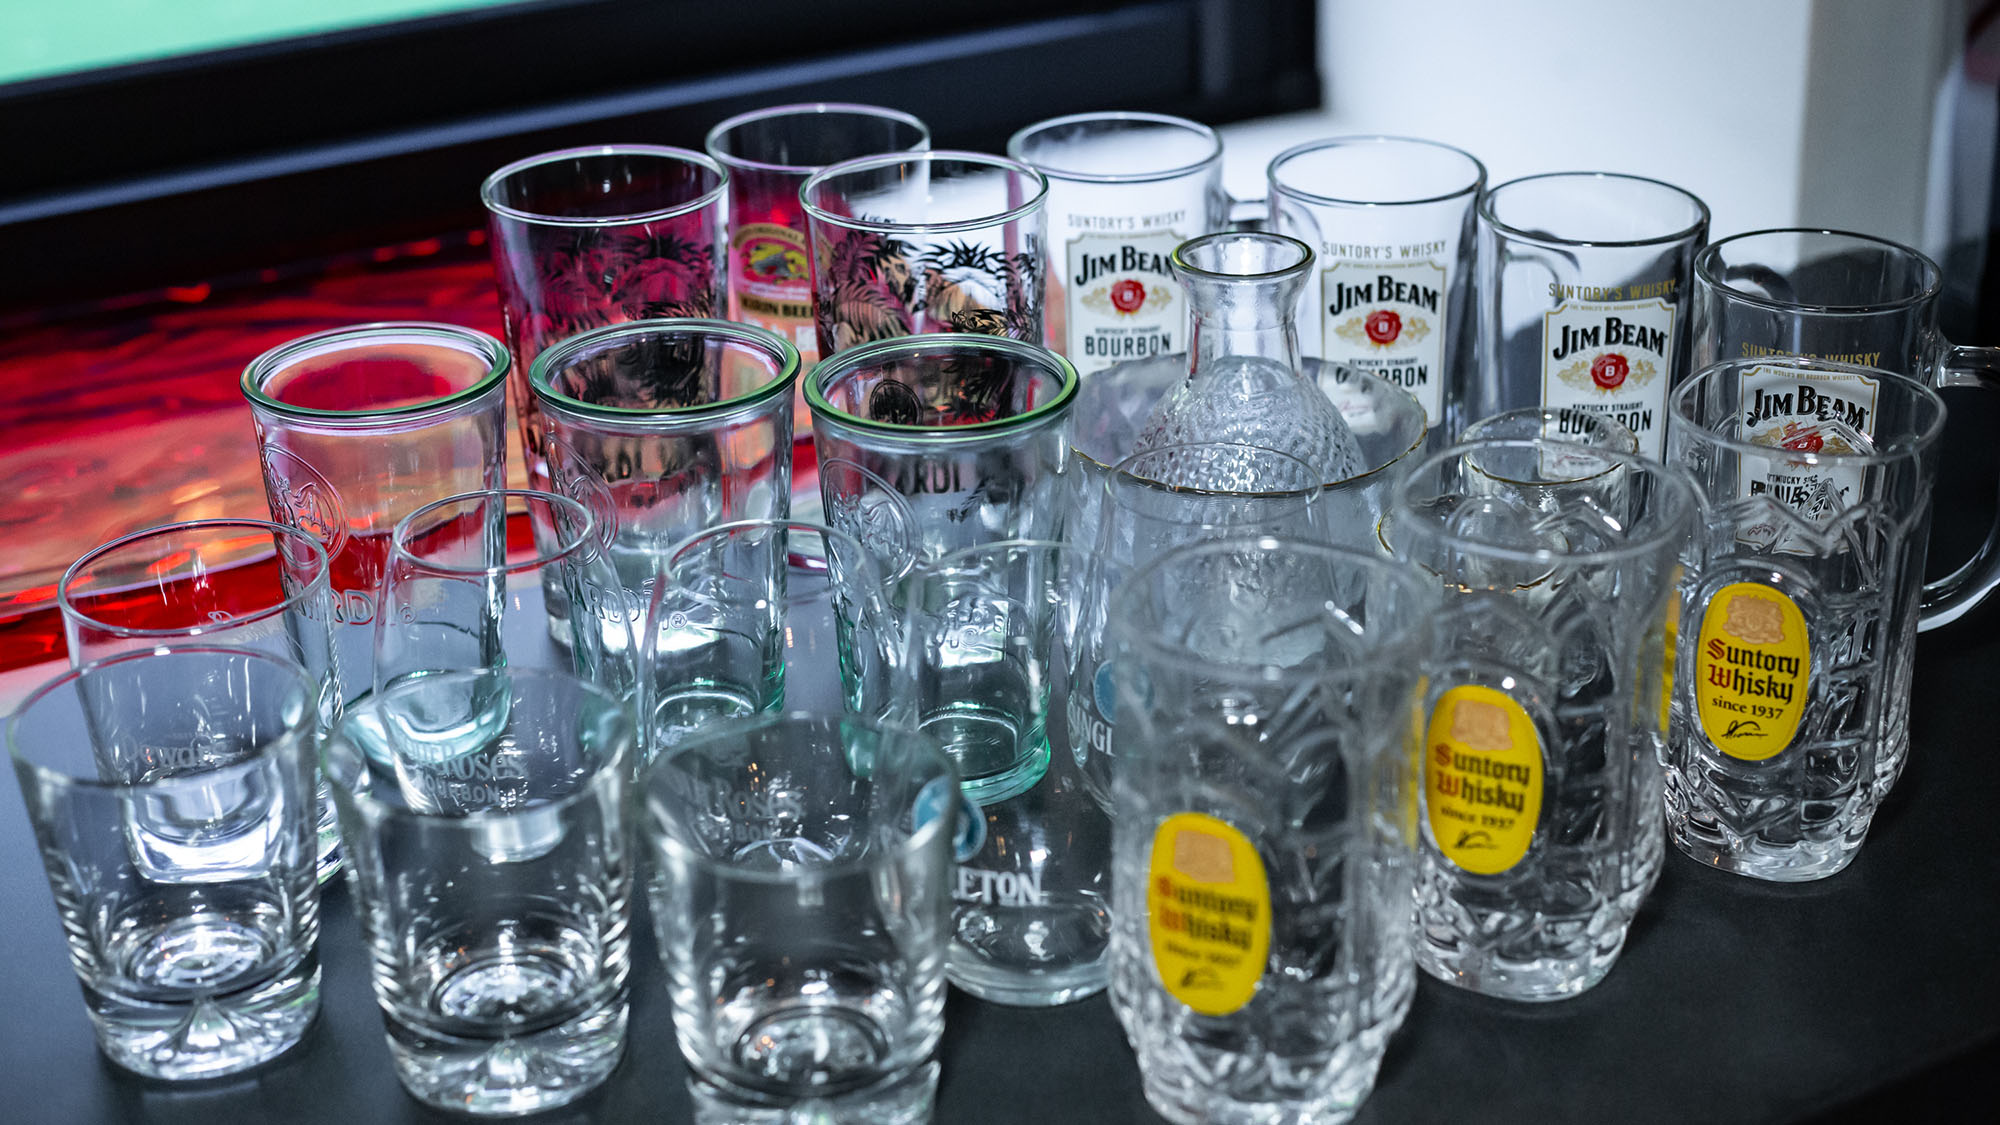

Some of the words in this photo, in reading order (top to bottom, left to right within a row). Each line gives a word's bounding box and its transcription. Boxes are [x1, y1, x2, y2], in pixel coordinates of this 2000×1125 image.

[1075, 252, 1116, 286] JIM
[1321, 241, 1392, 259] SUNTORY'S
[1400, 240, 1446, 258] WHISKY
[1329, 282, 1373, 316] JIM
[1377, 275, 1439, 314] BEAM
[1548, 282, 1623, 300] SUNTORY'S
[1630, 278, 1676, 299] WHISKY
[1085, 332, 1171, 356] BOURBON
[1553, 325, 1600, 360] JIM
[1604, 317, 1664, 357] BEAM
[1746, 388, 1794, 427] JIM
[1796, 385, 1868, 433] BEAM
[1706, 638, 1800, 680] Suntory
[1707, 663, 1794, 705] Whisky
[1712, 696, 1748, 714] since
[1751, 704, 1784, 720] 1937
[1434, 743, 1530, 788] Suntory
[1436, 770, 1525, 814] Whisky
